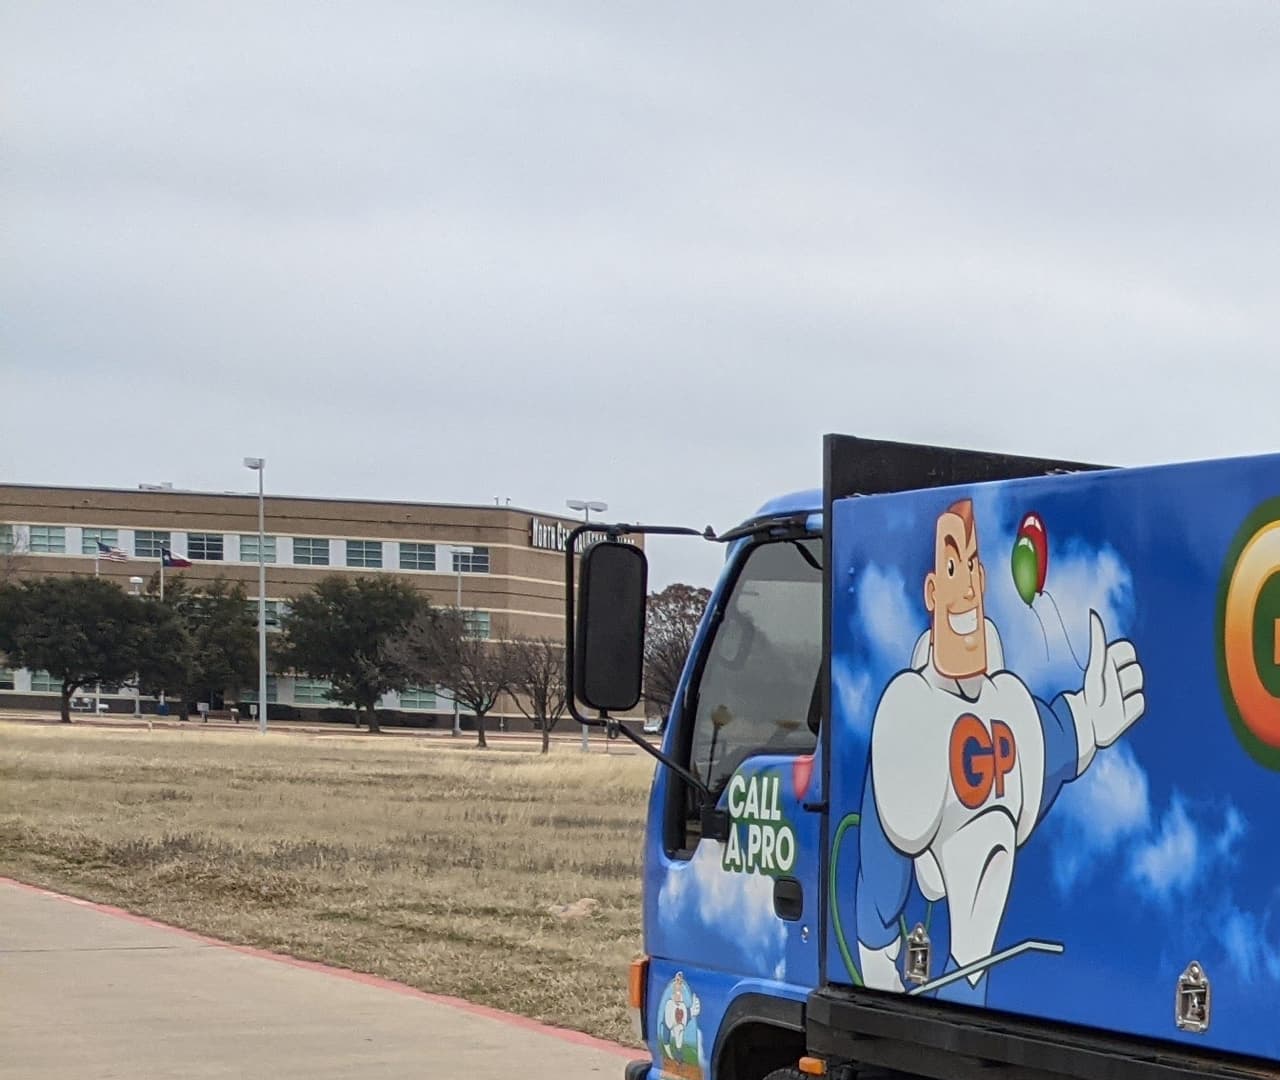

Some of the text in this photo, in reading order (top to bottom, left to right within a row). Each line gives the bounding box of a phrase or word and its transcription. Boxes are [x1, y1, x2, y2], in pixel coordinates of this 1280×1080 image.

[949, 712, 1016, 810] GP
[728, 774, 781, 821] CALL
[724, 822, 795, 872] A PRO
